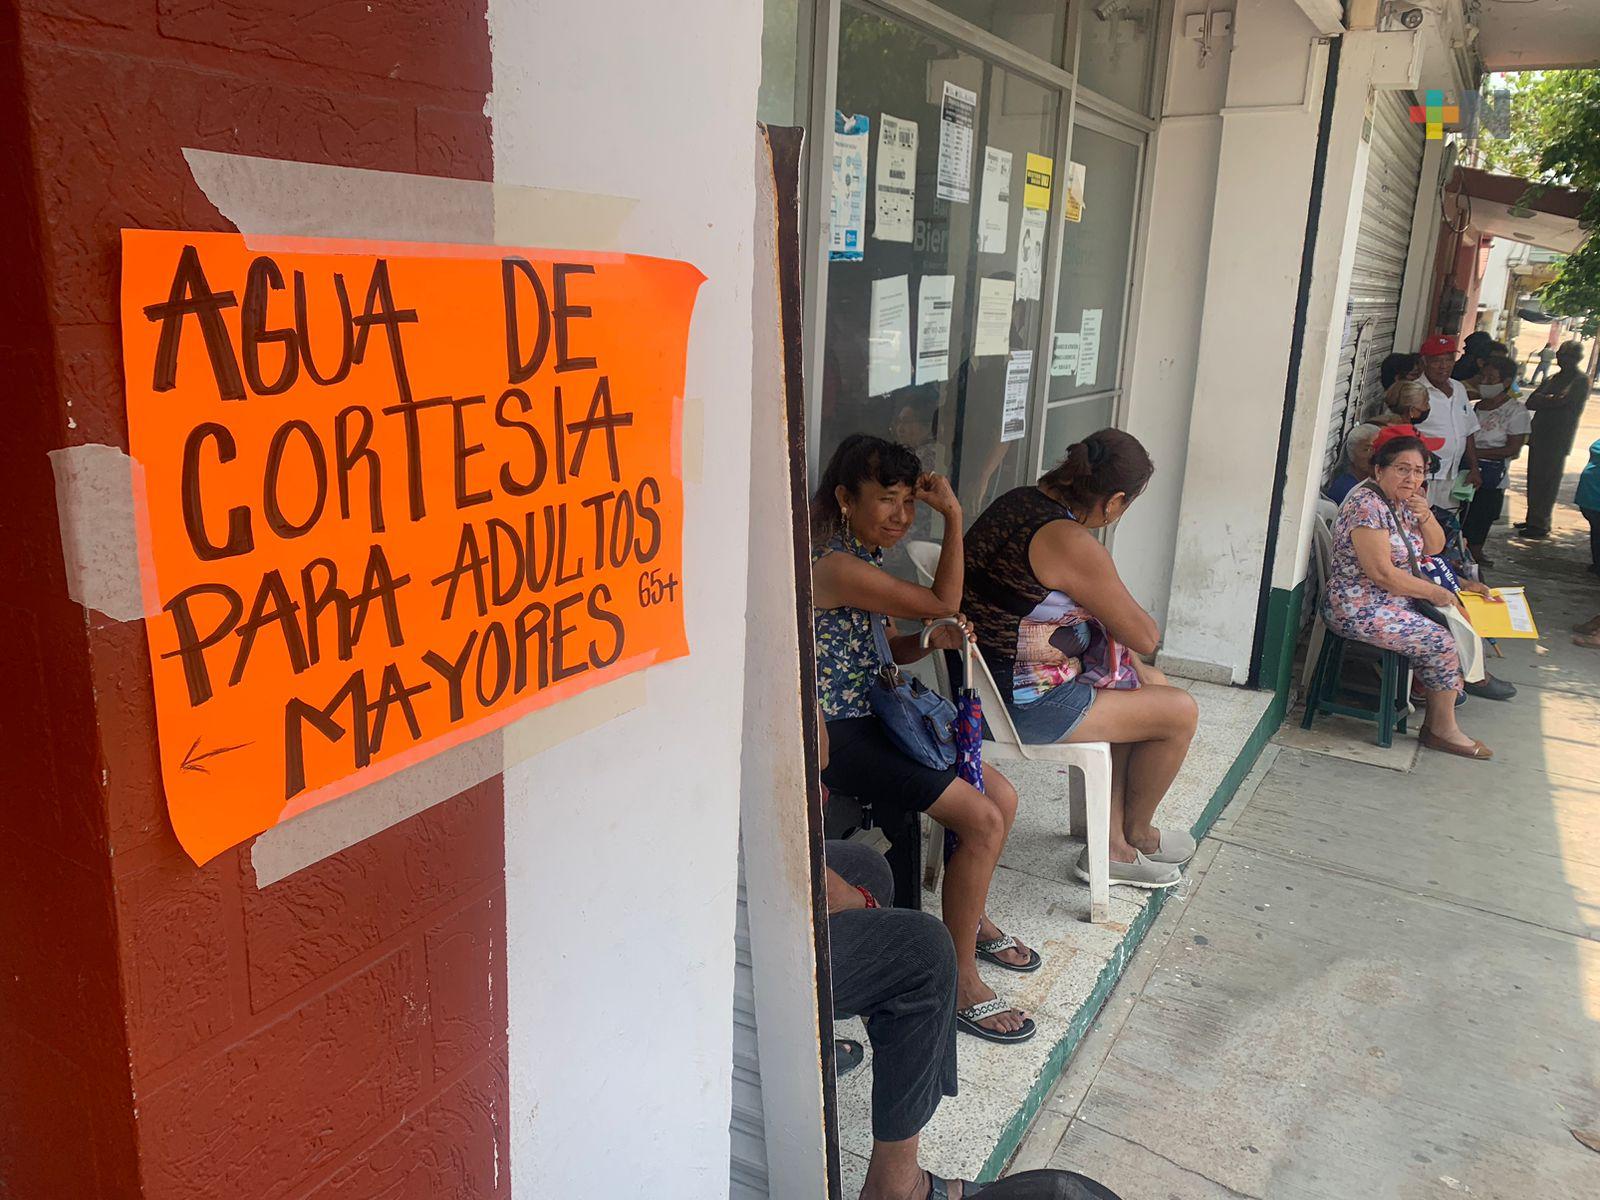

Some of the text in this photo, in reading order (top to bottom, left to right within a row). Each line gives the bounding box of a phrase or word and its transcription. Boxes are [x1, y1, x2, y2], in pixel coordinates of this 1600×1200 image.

[144, 245, 597, 402] AGUA DE
[181, 376, 632, 561] CORTESIA
[161, 477, 660, 707] PARA ADULTOS
[285, 569, 678, 800] MAYORES 65+
